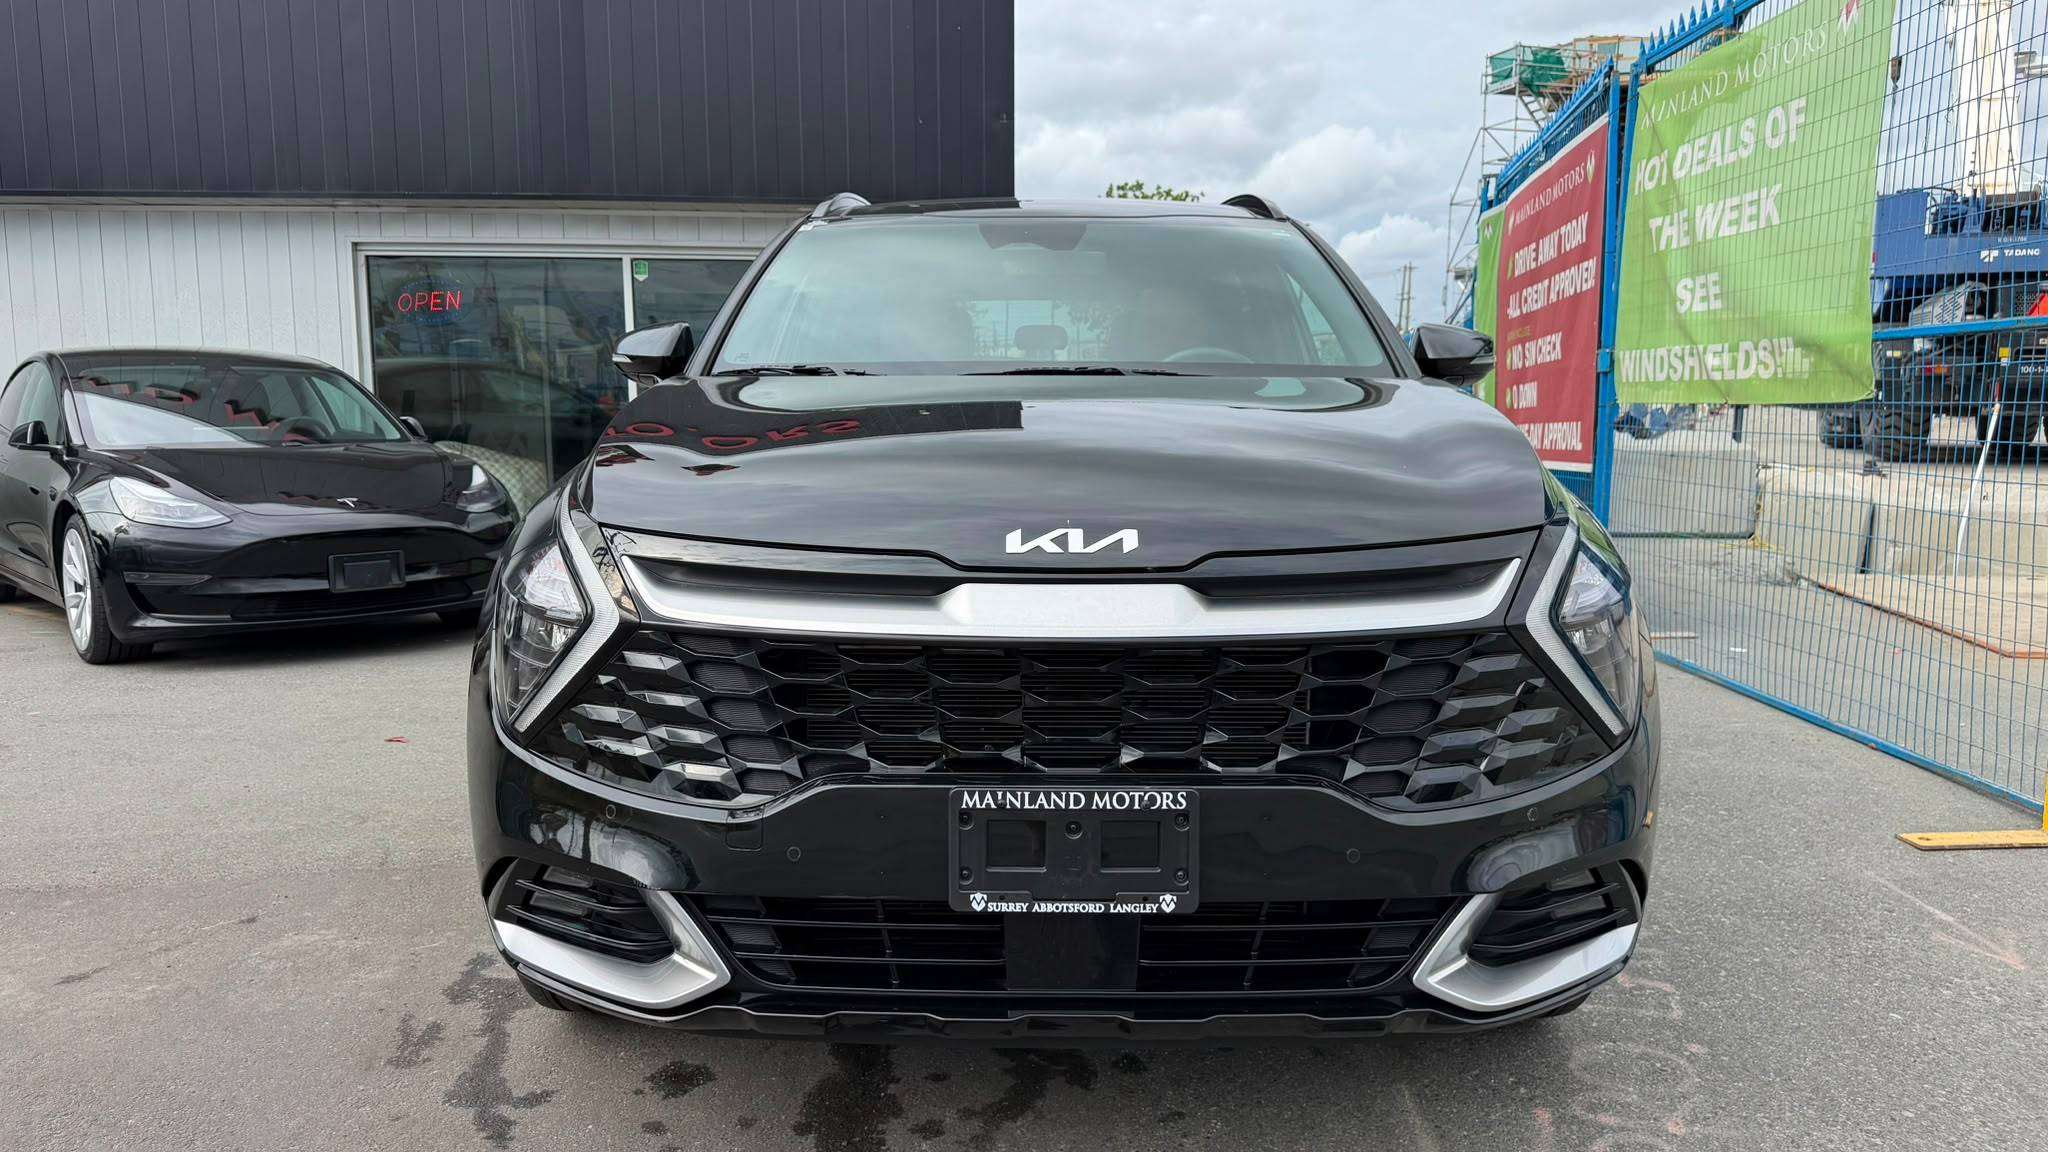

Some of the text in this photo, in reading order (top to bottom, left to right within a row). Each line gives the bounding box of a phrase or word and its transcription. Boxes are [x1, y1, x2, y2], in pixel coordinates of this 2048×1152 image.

[1734, 21, 1827, 87] MOTORS
[1672, 117, 1756, 181] DEALS
[1765, 96, 1807, 149] OF
[1515, 163, 1584, 226] MAINLAND MOTORS
[1649, 183, 1782, 253] THE WEEK
[1514, 212, 1588, 277] DRIVE AWAY TODAY
[397, 290, 462, 311] OPEN
[1521, 278, 1549, 314] CREDIT
[1549, 257, 1596, 305] APPROVED!
[1676, 272, 1722, 314] SEE
[1512, 343, 1523, 370] NO
[1524, 340, 1536, 368] SIN
[1537, 332, 1562, 364] CHECK
[1519, 381, 1538, 408] DOWN
[1543, 421, 1583, 451] APPROVAL
[1005, 528, 1139, 554] KIA
[1091, 790, 1188, 810] MOTORS
[987, 902, 1159, 914] SURREY ABBOTSFORD LANGLEY
